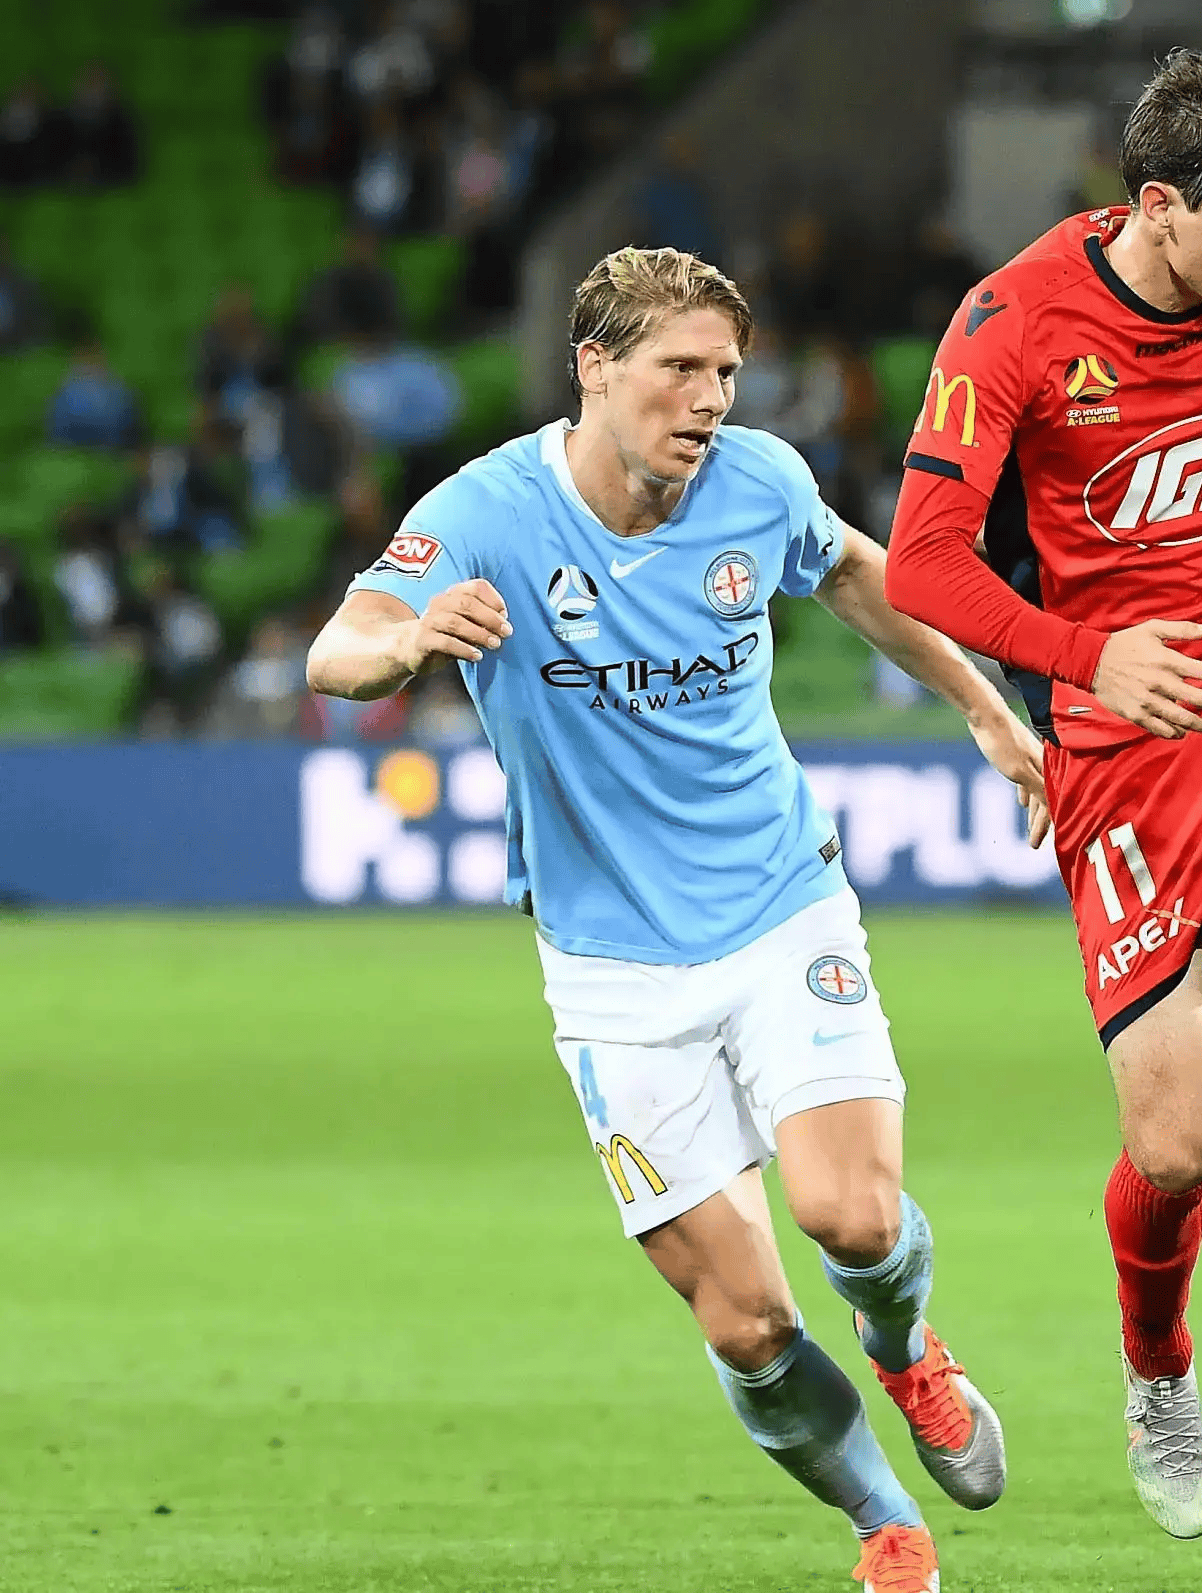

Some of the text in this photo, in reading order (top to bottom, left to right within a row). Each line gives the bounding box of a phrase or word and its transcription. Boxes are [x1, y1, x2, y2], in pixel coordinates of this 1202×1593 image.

[540, 632, 759, 692] ETIHAD
[589, 678, 728, 714] AIRWAYS
[1085, 821, 1157, 925] 11
[1097, 896, 1200, 991] APEX
[579, 1045, 609, 1129] 4
